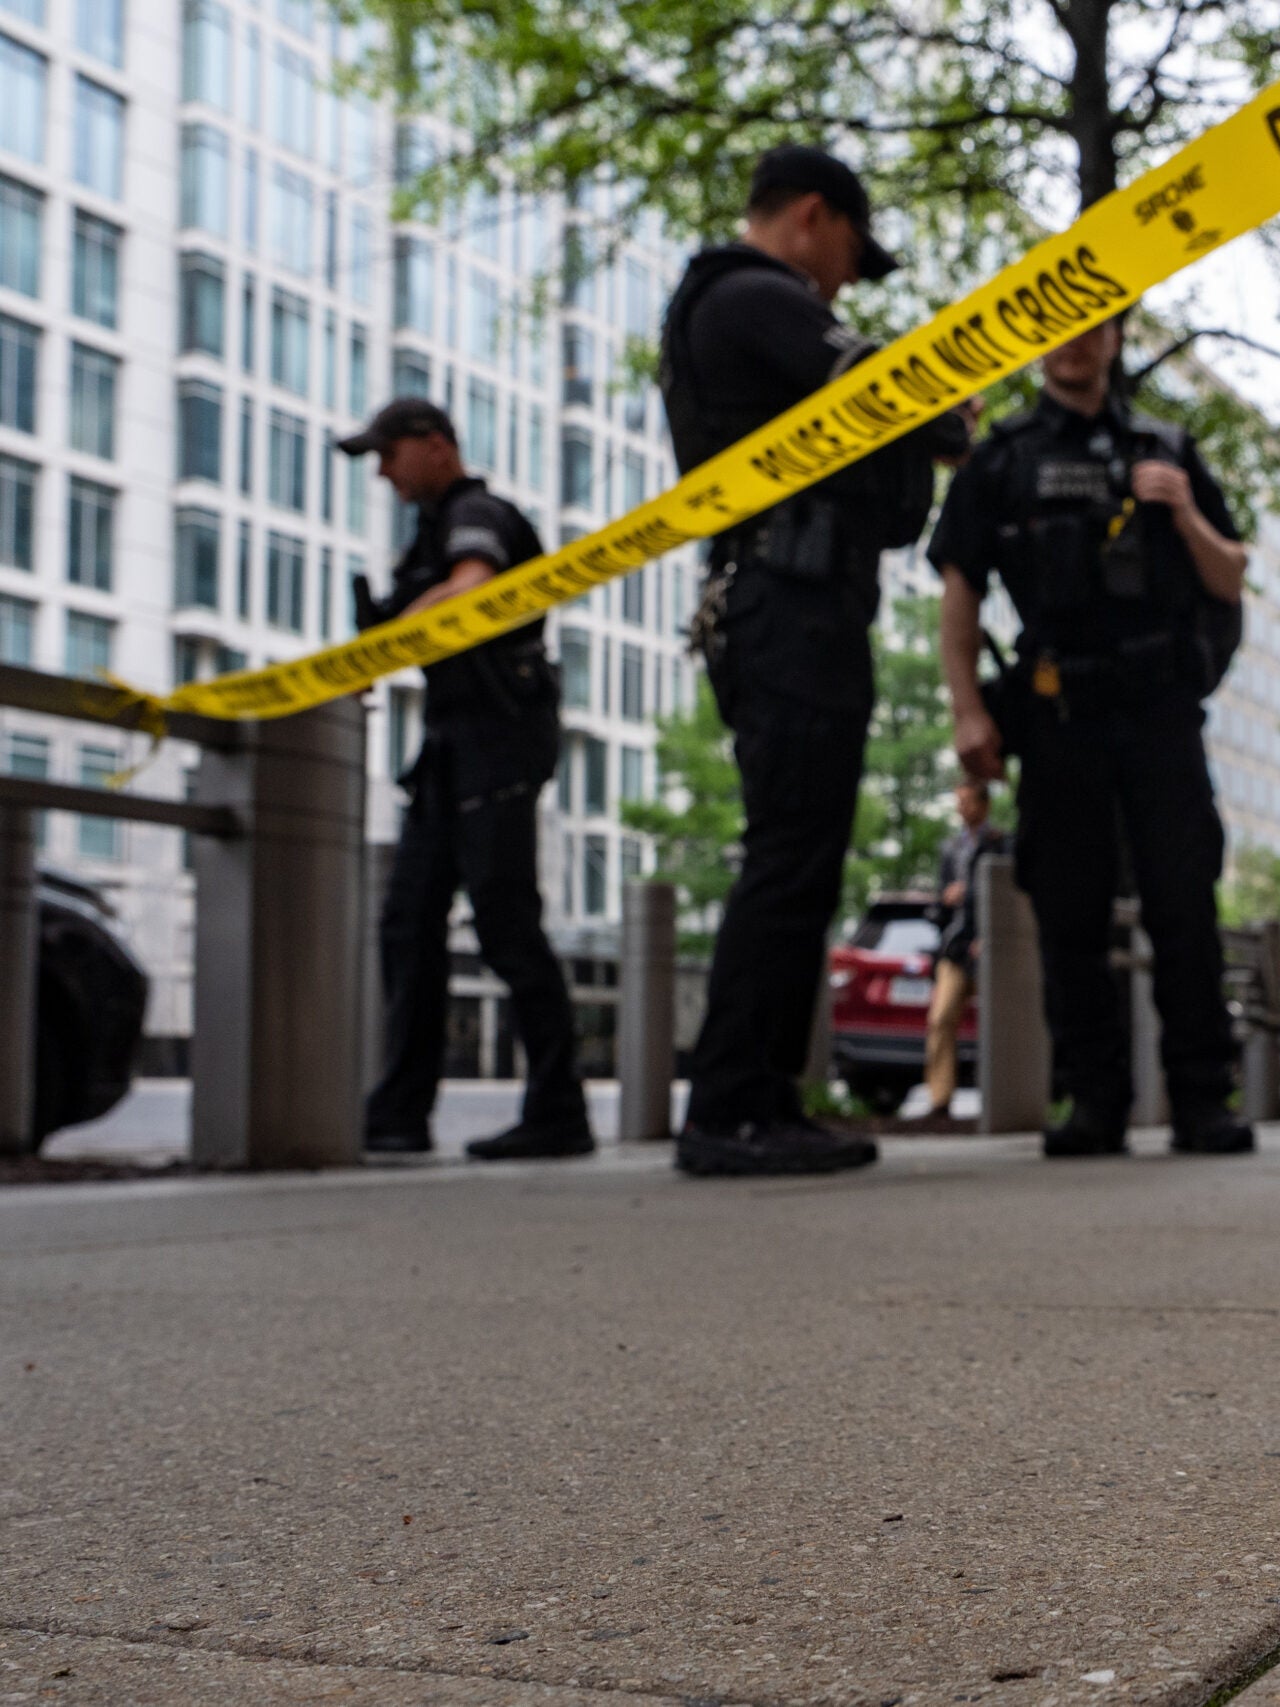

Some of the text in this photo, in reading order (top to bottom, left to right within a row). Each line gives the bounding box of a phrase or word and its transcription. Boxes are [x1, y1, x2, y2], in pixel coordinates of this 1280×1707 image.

[751, 418, 861, 486] POLICE
[828, 379, 921, 440] LINE
[889, 354, 960, 406] DO
[930, 311, 1020, 383] NOT
[996, 243, 1130, 347] CROSS
